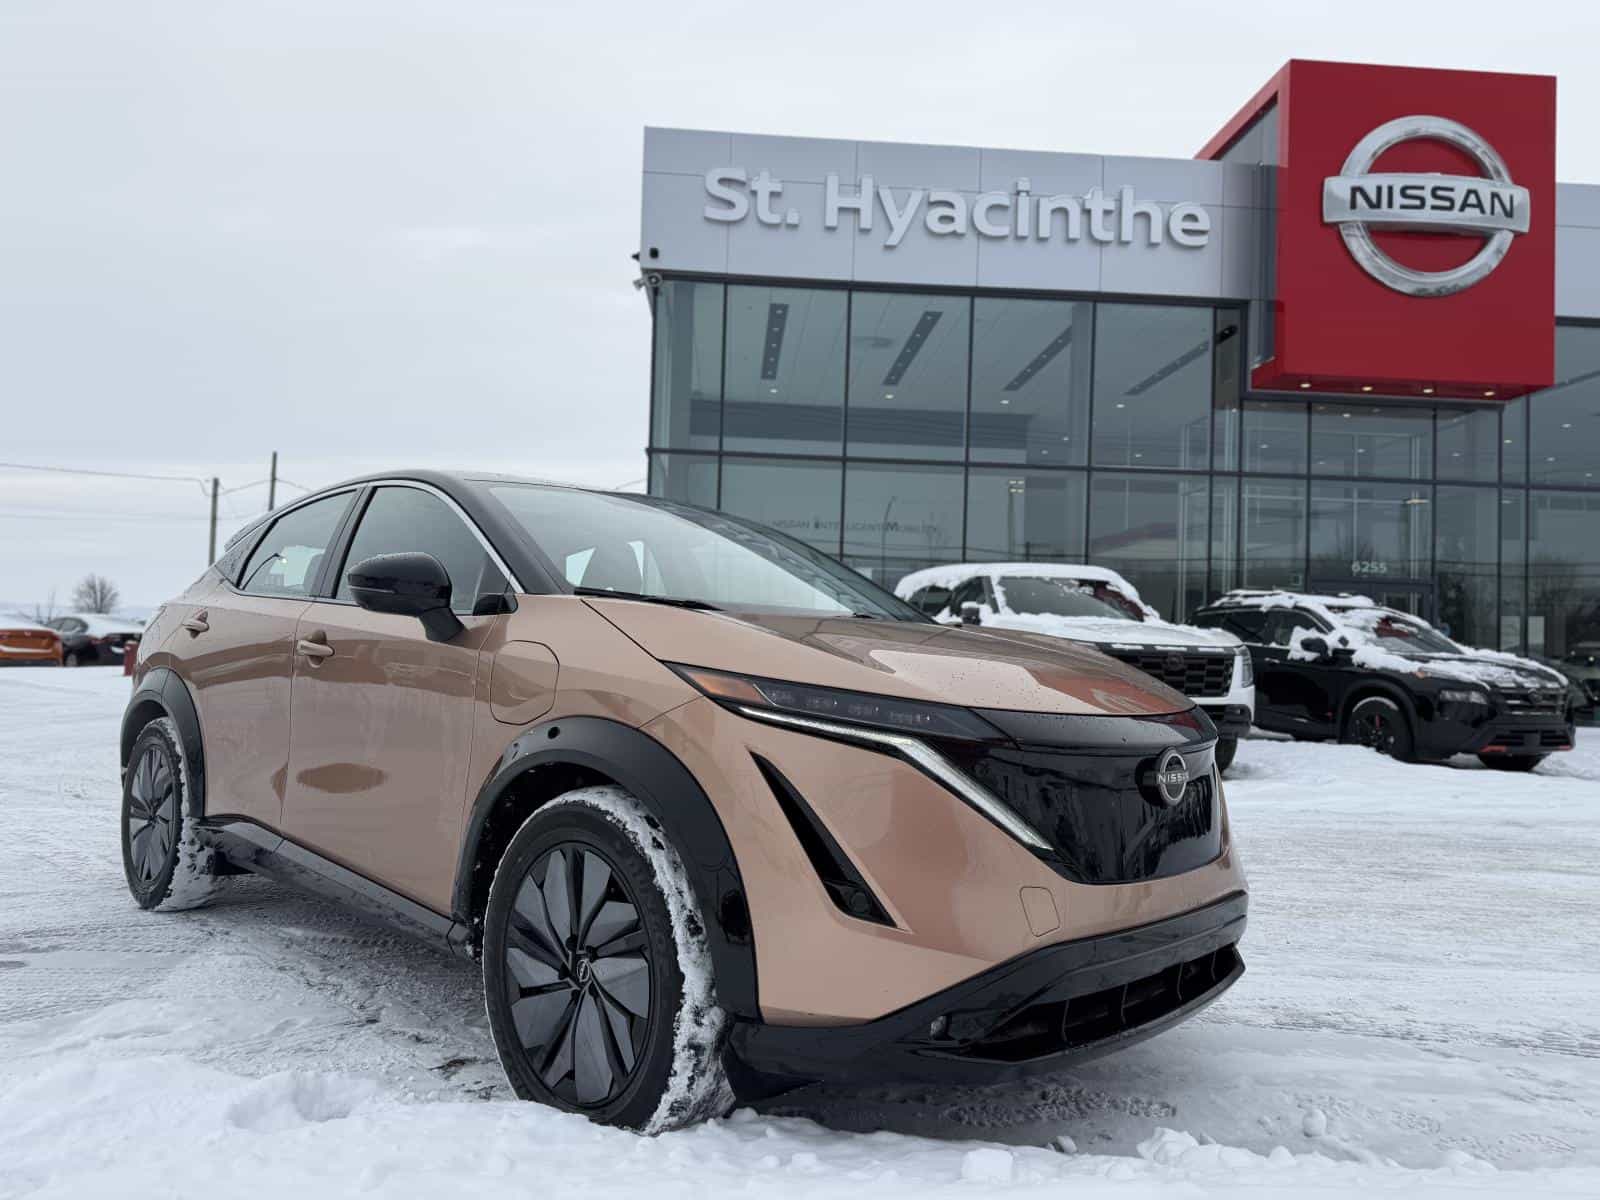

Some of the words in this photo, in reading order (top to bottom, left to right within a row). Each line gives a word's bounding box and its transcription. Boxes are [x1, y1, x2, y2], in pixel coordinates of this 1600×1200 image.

[703, 167, 801, 227] St.
[823, 173, 1211, 250] Hyacinthe
[1350, 184, 1514, 218] NISSAN
[1352, 560, 1388, 574] 6255
